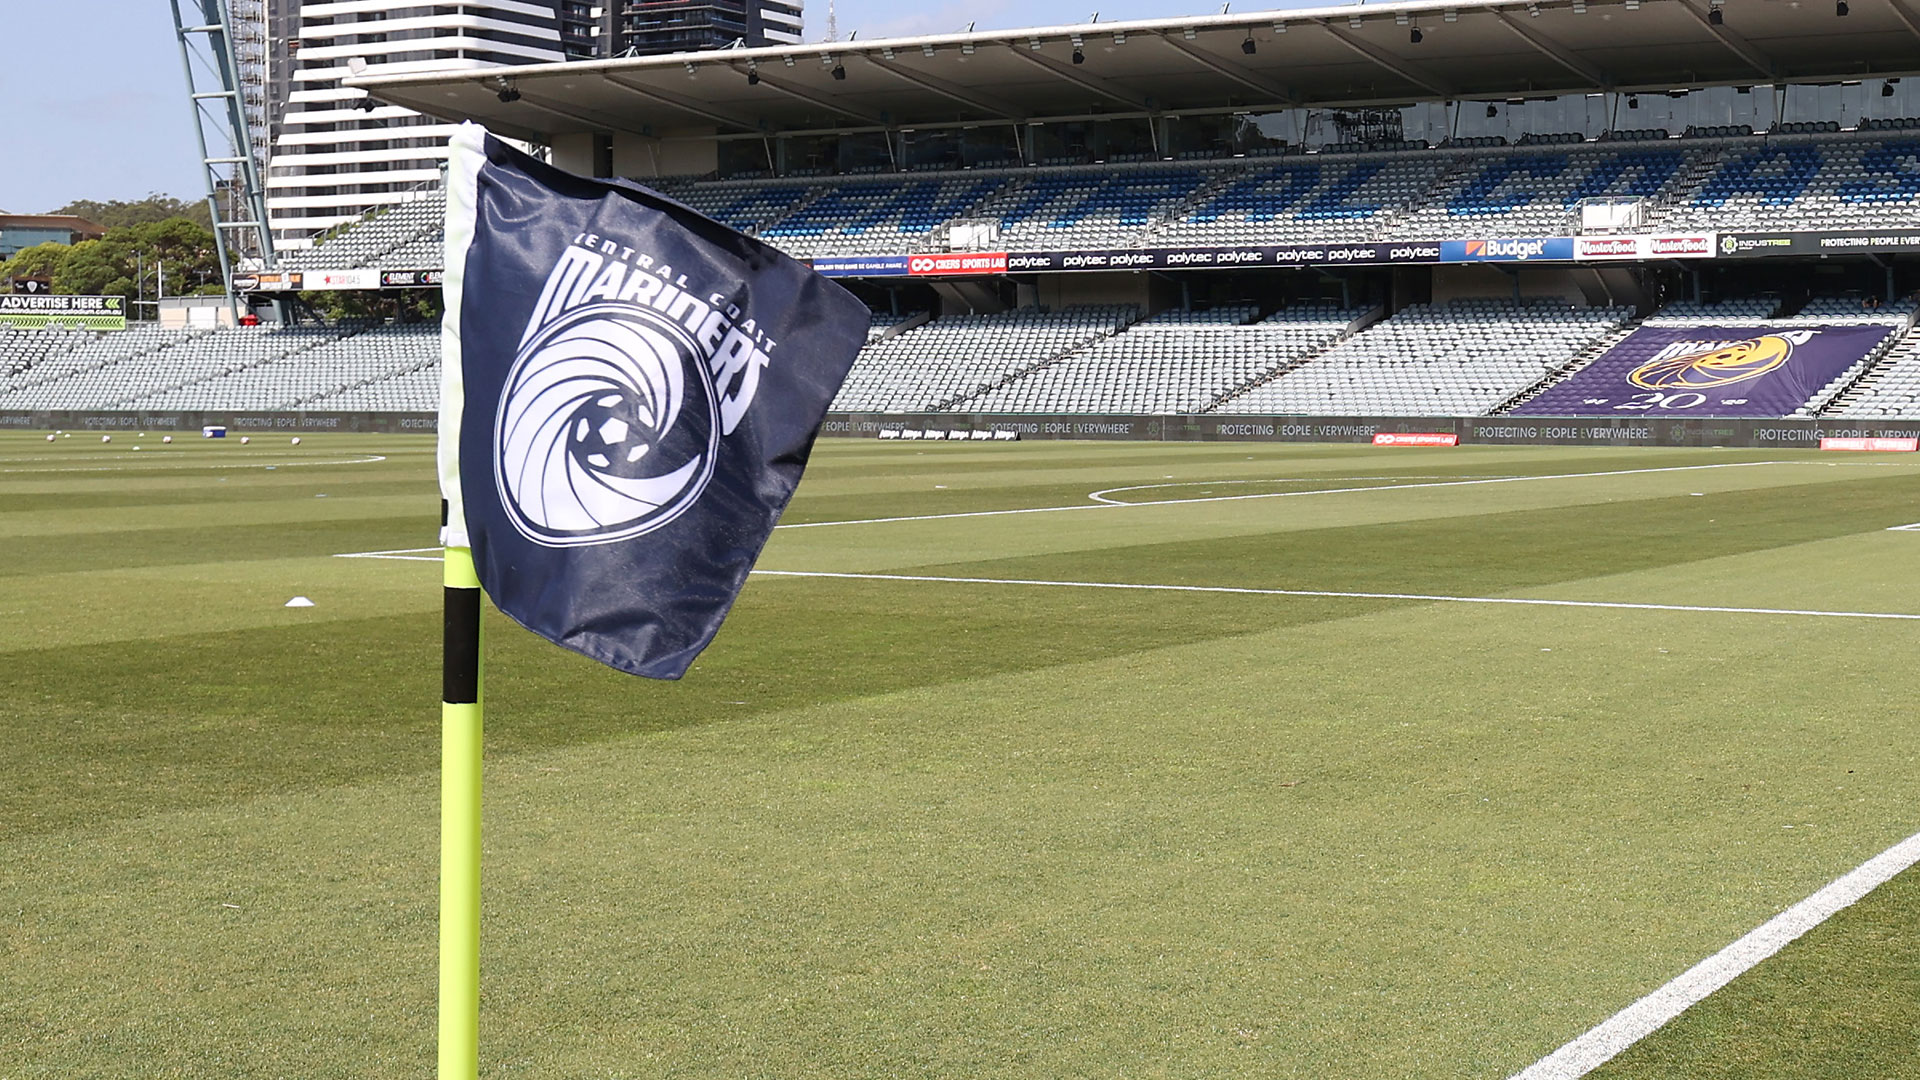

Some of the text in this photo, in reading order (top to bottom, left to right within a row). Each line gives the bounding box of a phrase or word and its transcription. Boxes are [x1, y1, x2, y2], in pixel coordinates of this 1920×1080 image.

[1580, 240, 1638, 255] MasterFoods
[1650, 239, 1709, 254] MasterFoods
[1738, 239, 1791, 247] INDUSTREE
[1820, 237, 1869, 247] PROTECTING
[1870, 237, 1899, 246] PEOPLE
[1486, 239, 1545, 260] Budget
[962, 258, 990, 269] SPORTS
[991, 257, 1006, 268] LAB
[1009, 246, 1440, 269] polytec polytec polytec polytec polytec polytec polytec polytec
[389, 272, 416, 282] ELEMENT
[1, 297, 103, 309] ADVERTISE HERE
[708, 292, 777, 353] COAST
[517, 244, 770, 436] MARINERS
[1612, 392, 1707, 410] 20
[821, 420, 850, 431] PEOPLE
[985, 422, 1129, 434] PROTECTING PEOPLE EVERYWHERE
[1216, 424, 1375, 436] PROTECTING PEOPLE EVERYWHERE
[1473, 426, 1648, 439] PROTECTING PEOPLE EVERYWHERE
[1753, 428, 1825, 440] PROTECTING
